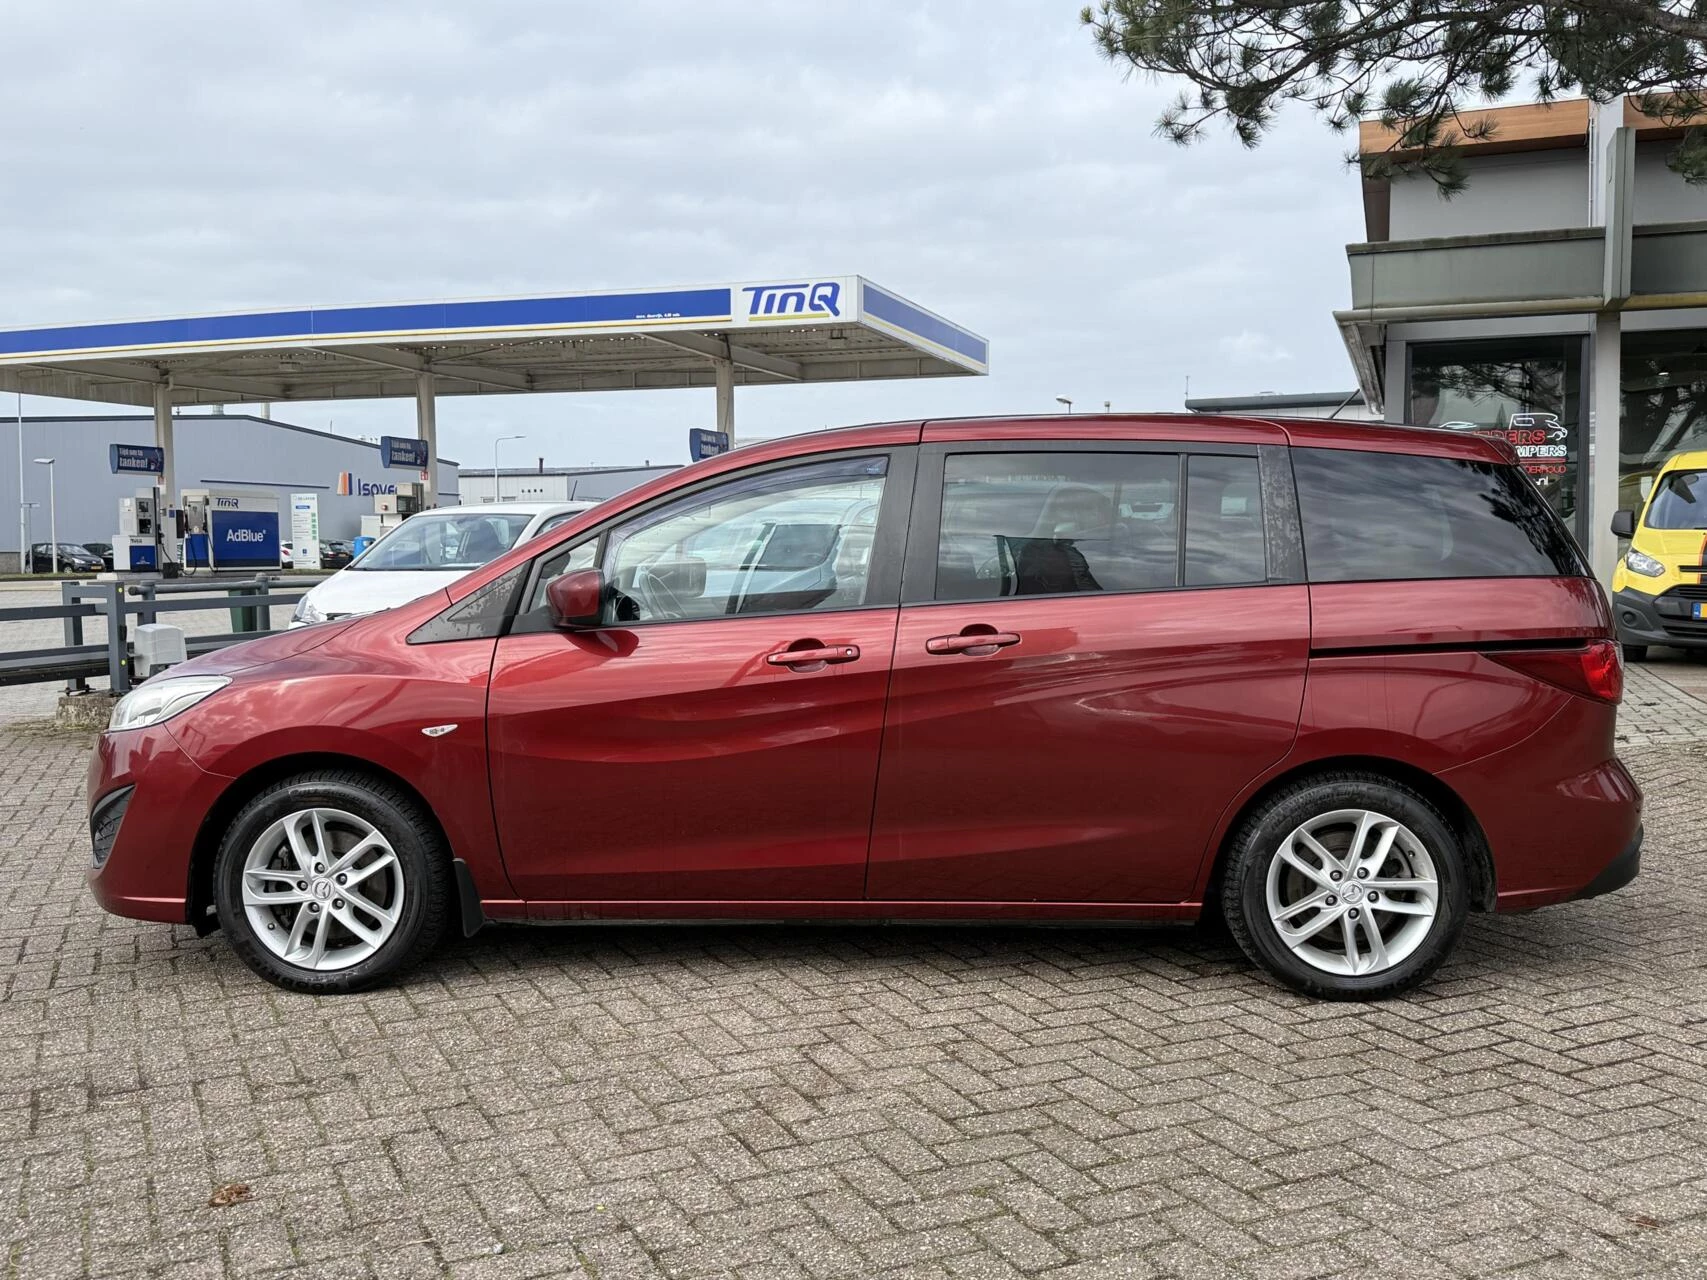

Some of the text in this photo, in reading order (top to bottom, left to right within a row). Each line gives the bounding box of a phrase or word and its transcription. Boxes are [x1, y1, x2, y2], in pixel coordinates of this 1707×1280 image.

[1515, 445, 1567, 457] MPERS
[119, 457, 148, 468] tanken!
[358, 478, 398, 496] Isove
